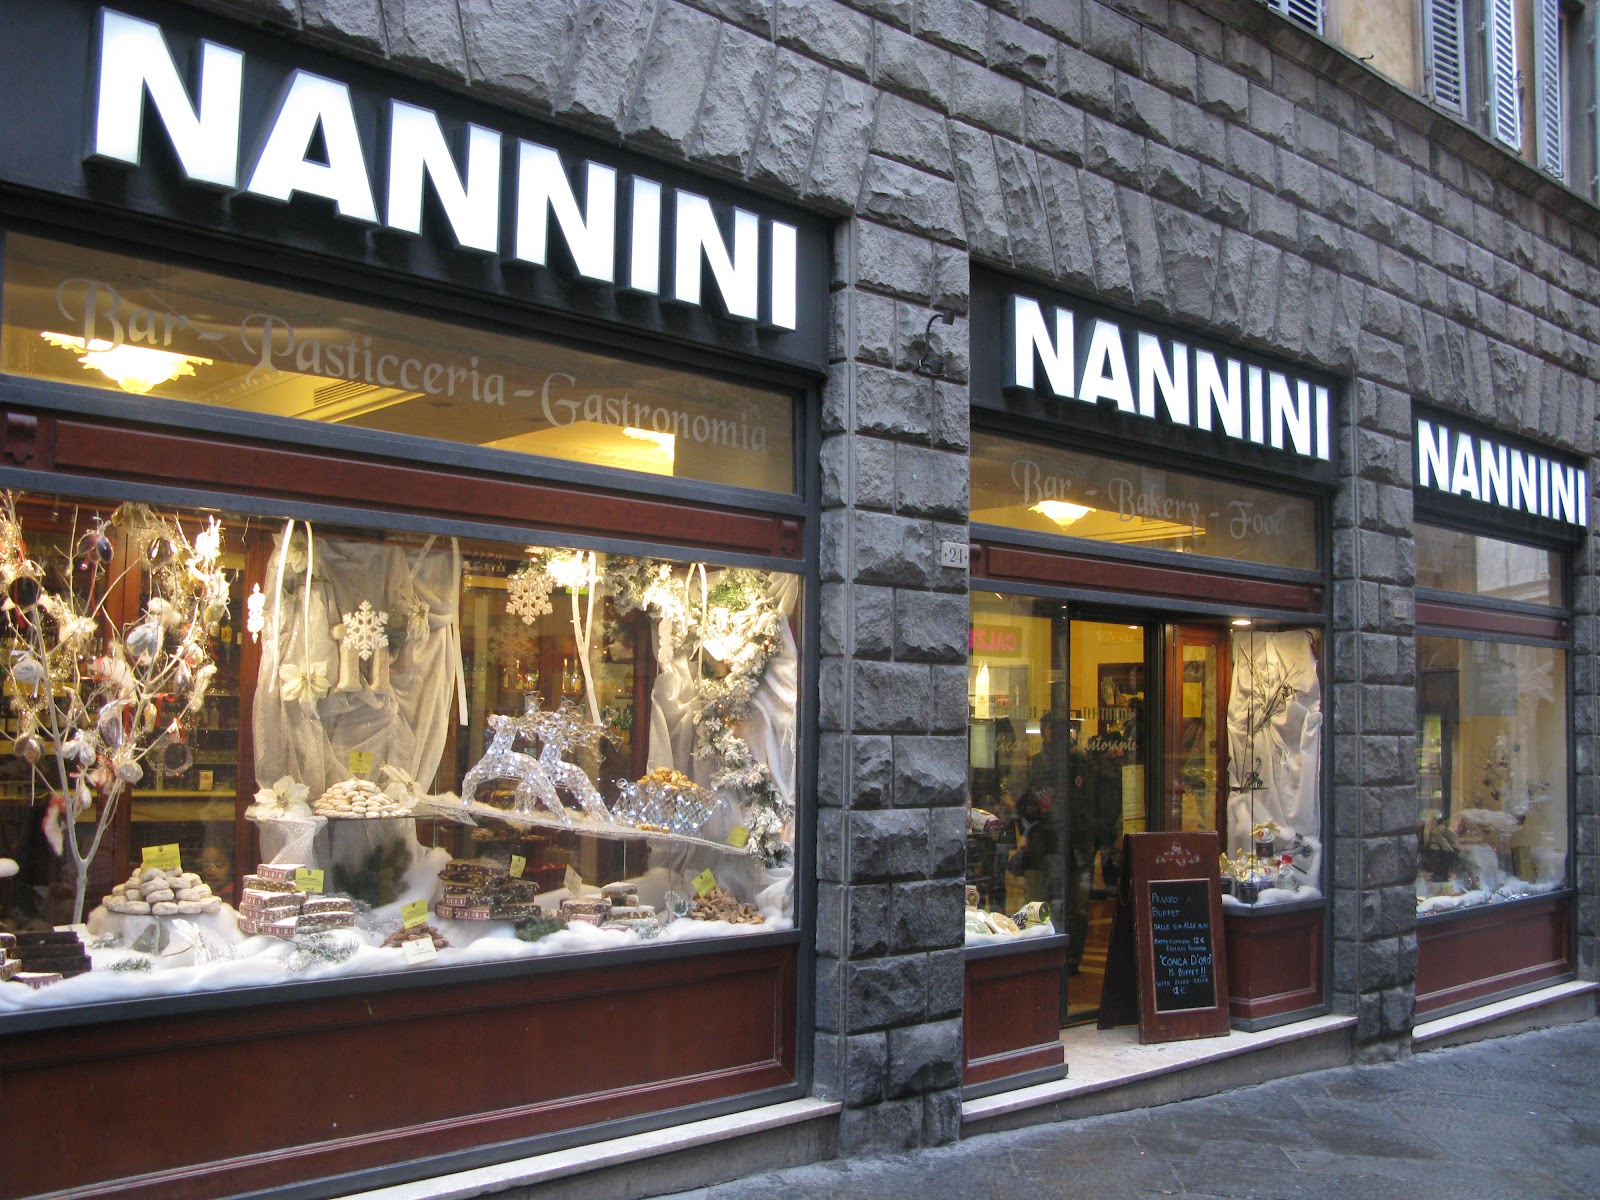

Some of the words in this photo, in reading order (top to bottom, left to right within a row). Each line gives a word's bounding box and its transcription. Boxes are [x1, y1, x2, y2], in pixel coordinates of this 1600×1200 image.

[92, 6, 798, 332] NANNINI
[56, 278, 189, 352] Bar
[240, 313, 506, 406] Pasticceria
[541, 372, 767, 450] Gastronomia
[1012, 294, 1330, 461] NANNINI
[1011, 459, 1072, 506] Bar
[1107, 478, 1201, 539] Bakery
[1226, 500, 1286, 539] Food
[1416, 417, 1588, 528] NANNINI
